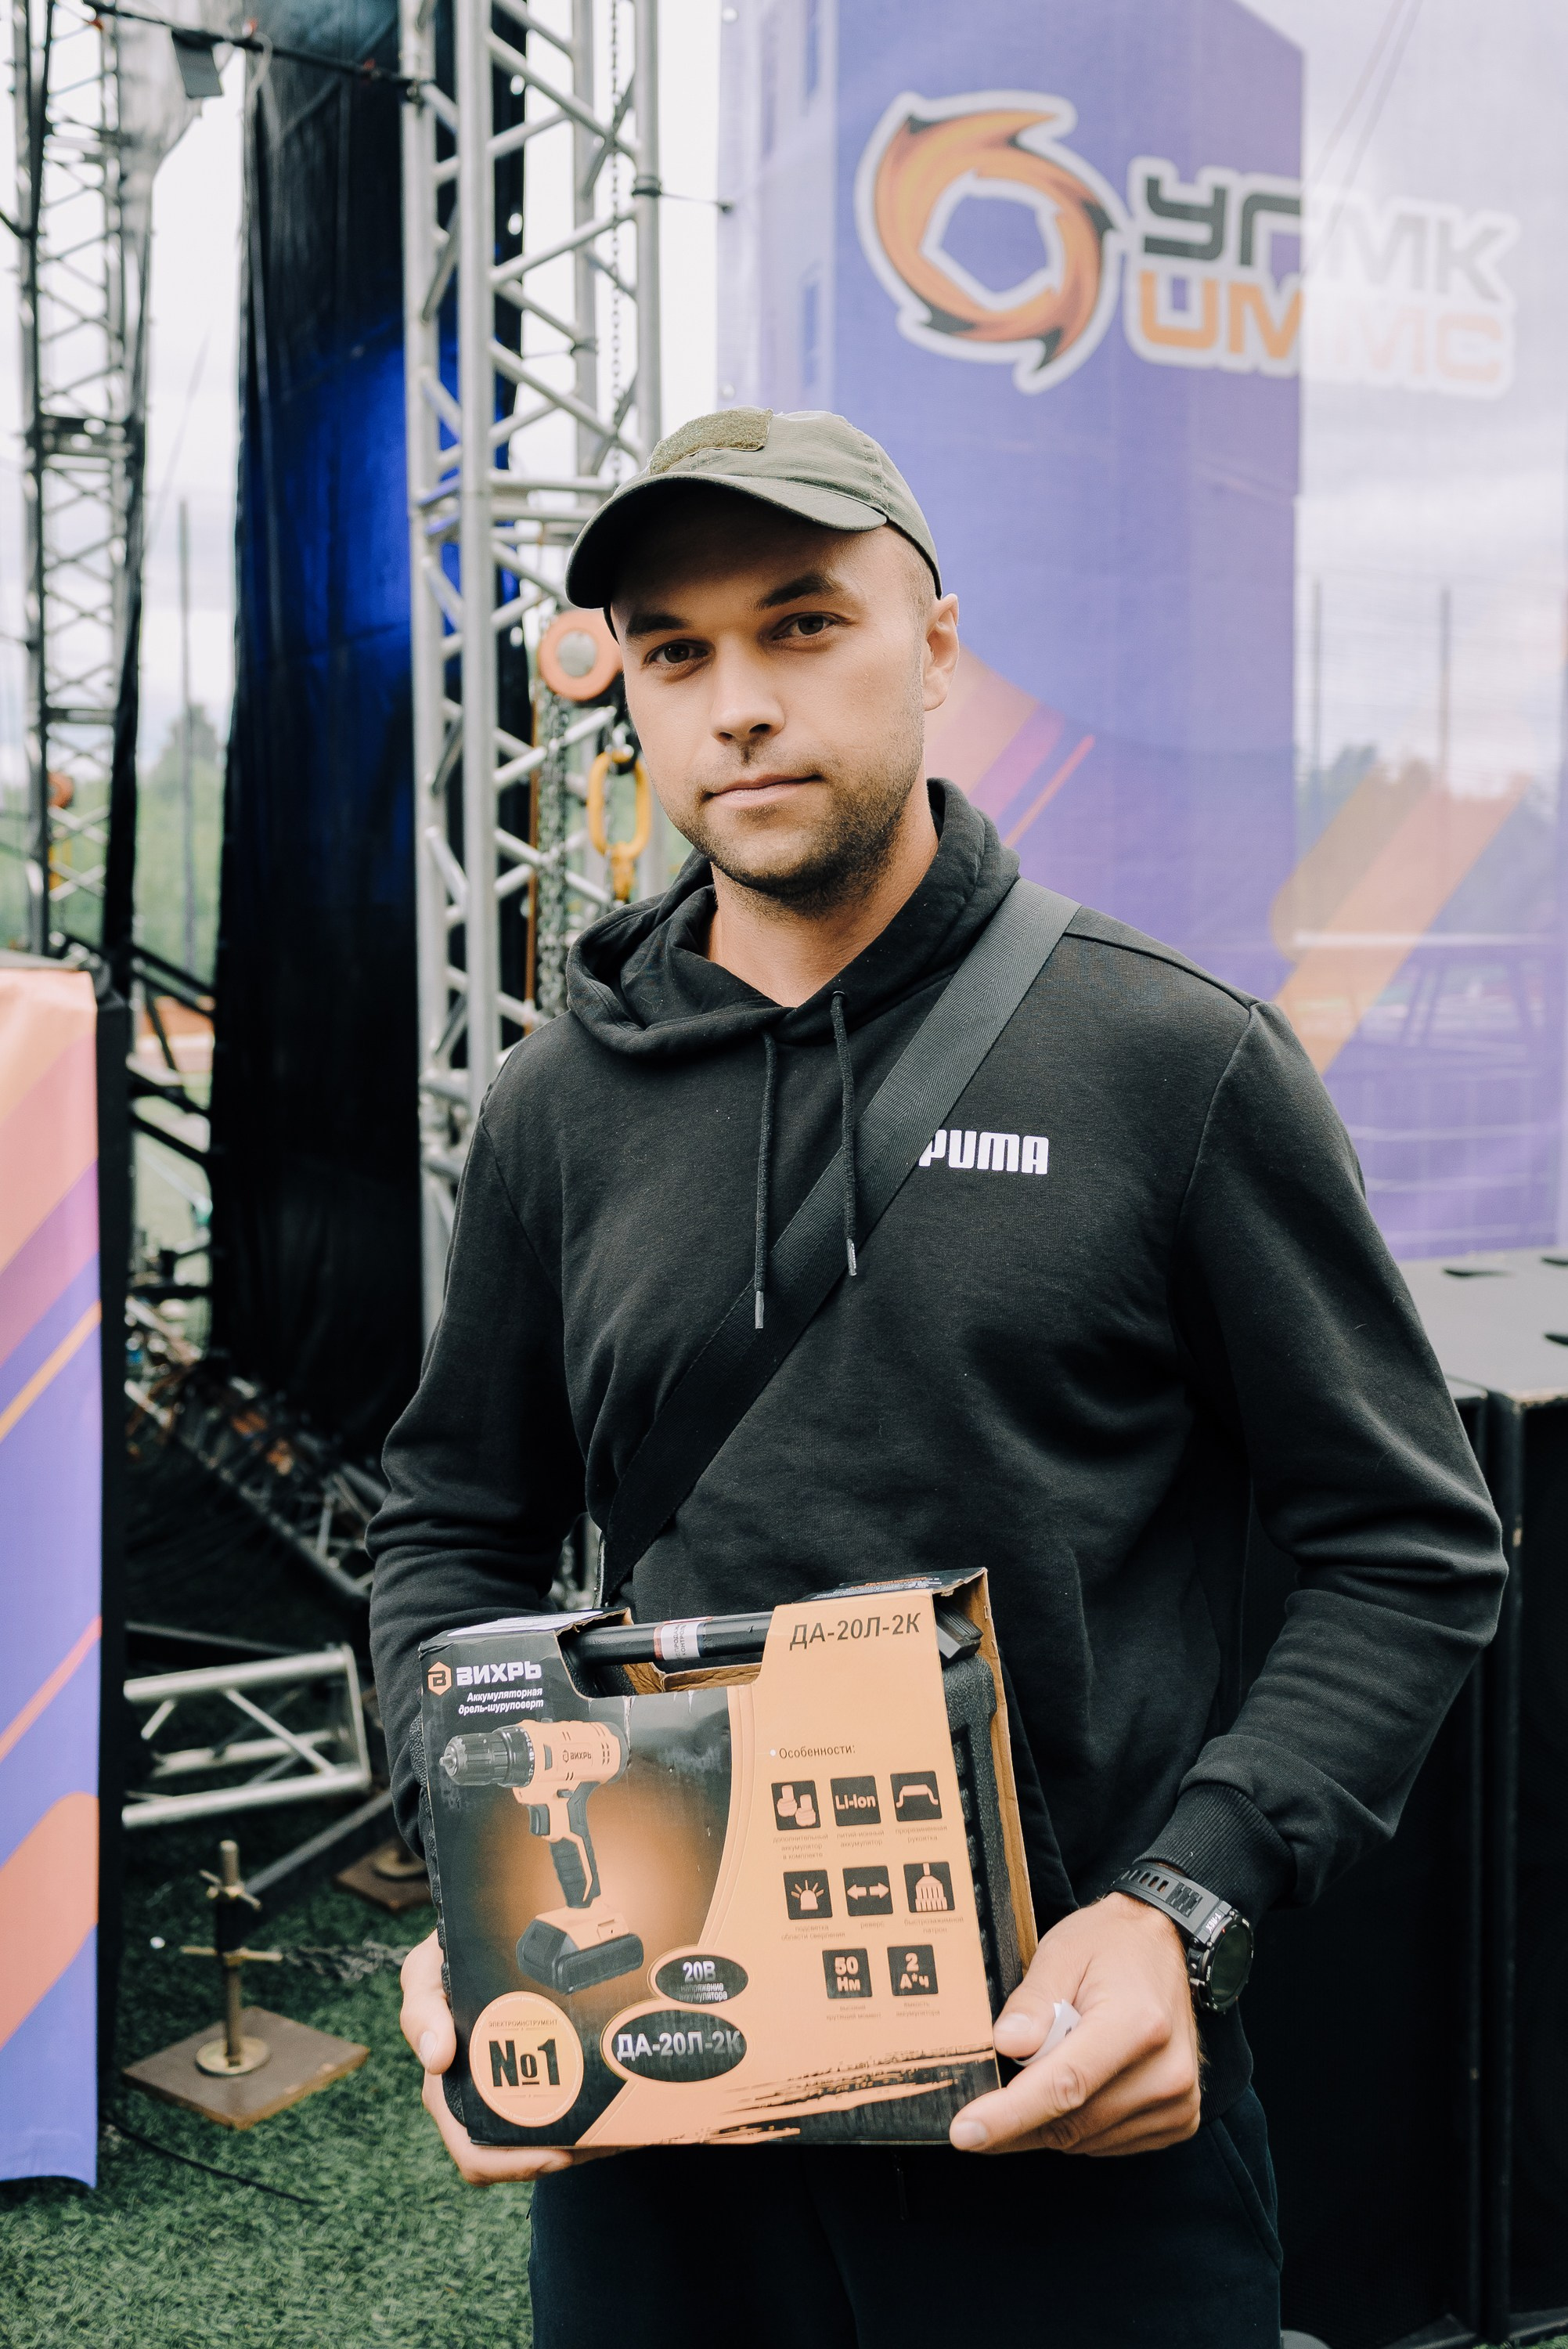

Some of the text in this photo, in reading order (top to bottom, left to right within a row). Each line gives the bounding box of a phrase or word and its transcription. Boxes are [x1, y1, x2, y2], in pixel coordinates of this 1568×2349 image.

[1144, 177, 1505, 302] УГМК
[1140, 270, 1503, 384] UMMC
[918, 1129, 1049, 1174] PUMA
[789, 1613, 921, 1651] ДА-20Л-2К
[456, 1661, 542, 1687] ВИХРЬ
[467, 1687, 543, 1703] Аккумуляторная
[458, 1698, 544, 1716] дрель-шуруповерт
[570, 1751, 592, 1760] ВИХРЬ
[778, 1745, 856, 1759] Особенности:
[683, 1960, 716, 1983] 20В
[834, 1955, 859, 1976] 50
[905, 1951, 920, 1972] 2
[488, 2018, 558, 2029] ЭЛЕКТРОИНСТРУМЕНТ
[617, 2030, 743, 2062] ДА-20Л-2К
